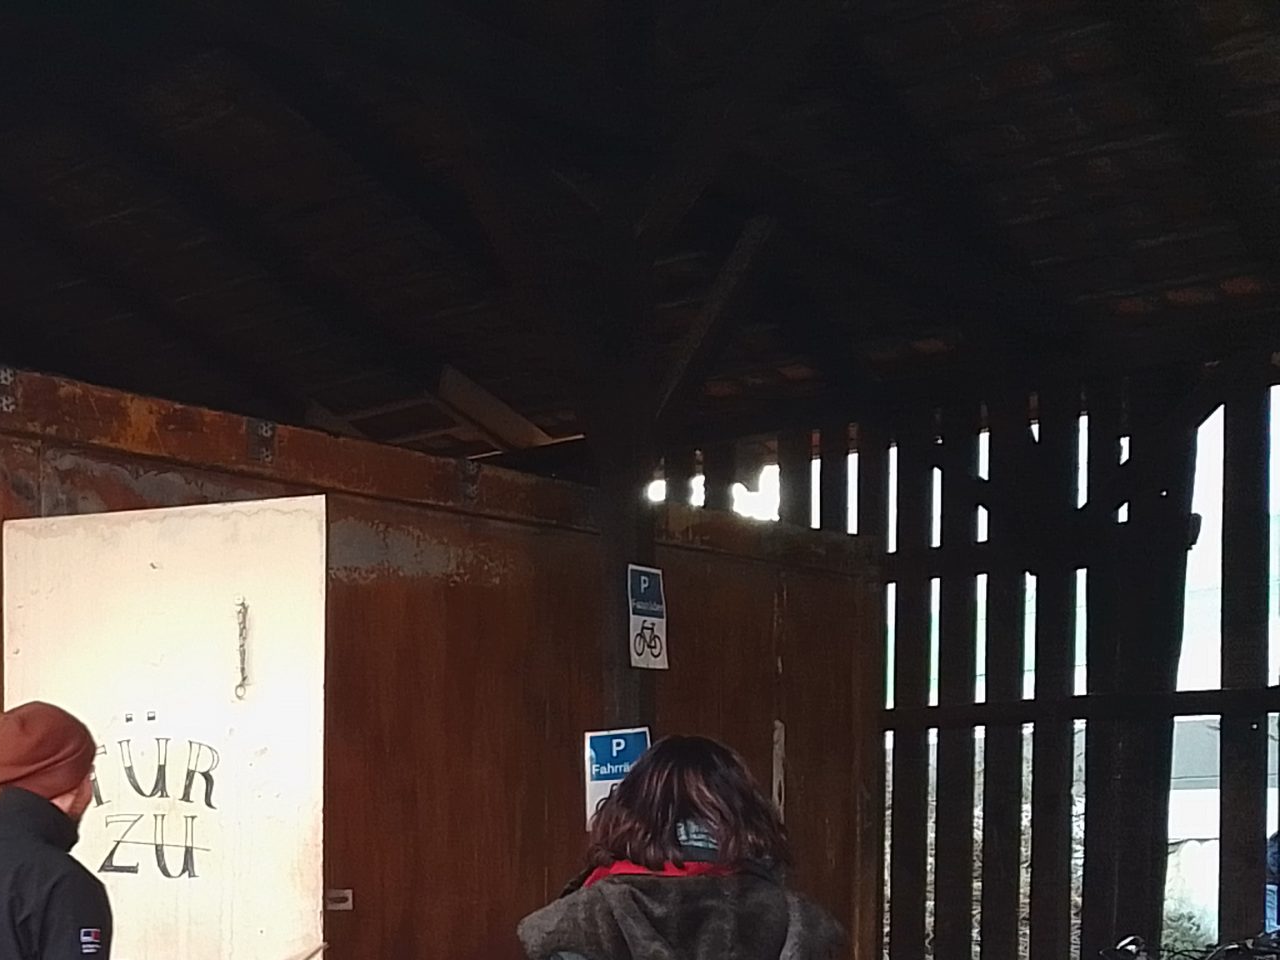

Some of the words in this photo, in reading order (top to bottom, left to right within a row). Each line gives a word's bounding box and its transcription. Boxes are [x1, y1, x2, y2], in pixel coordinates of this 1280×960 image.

[640, 575, 649, 593] P
[612, 738, 626, 757] P
[592, 762, 631, 775] Fahrrä
[97, 813, 200, 878] ZU
